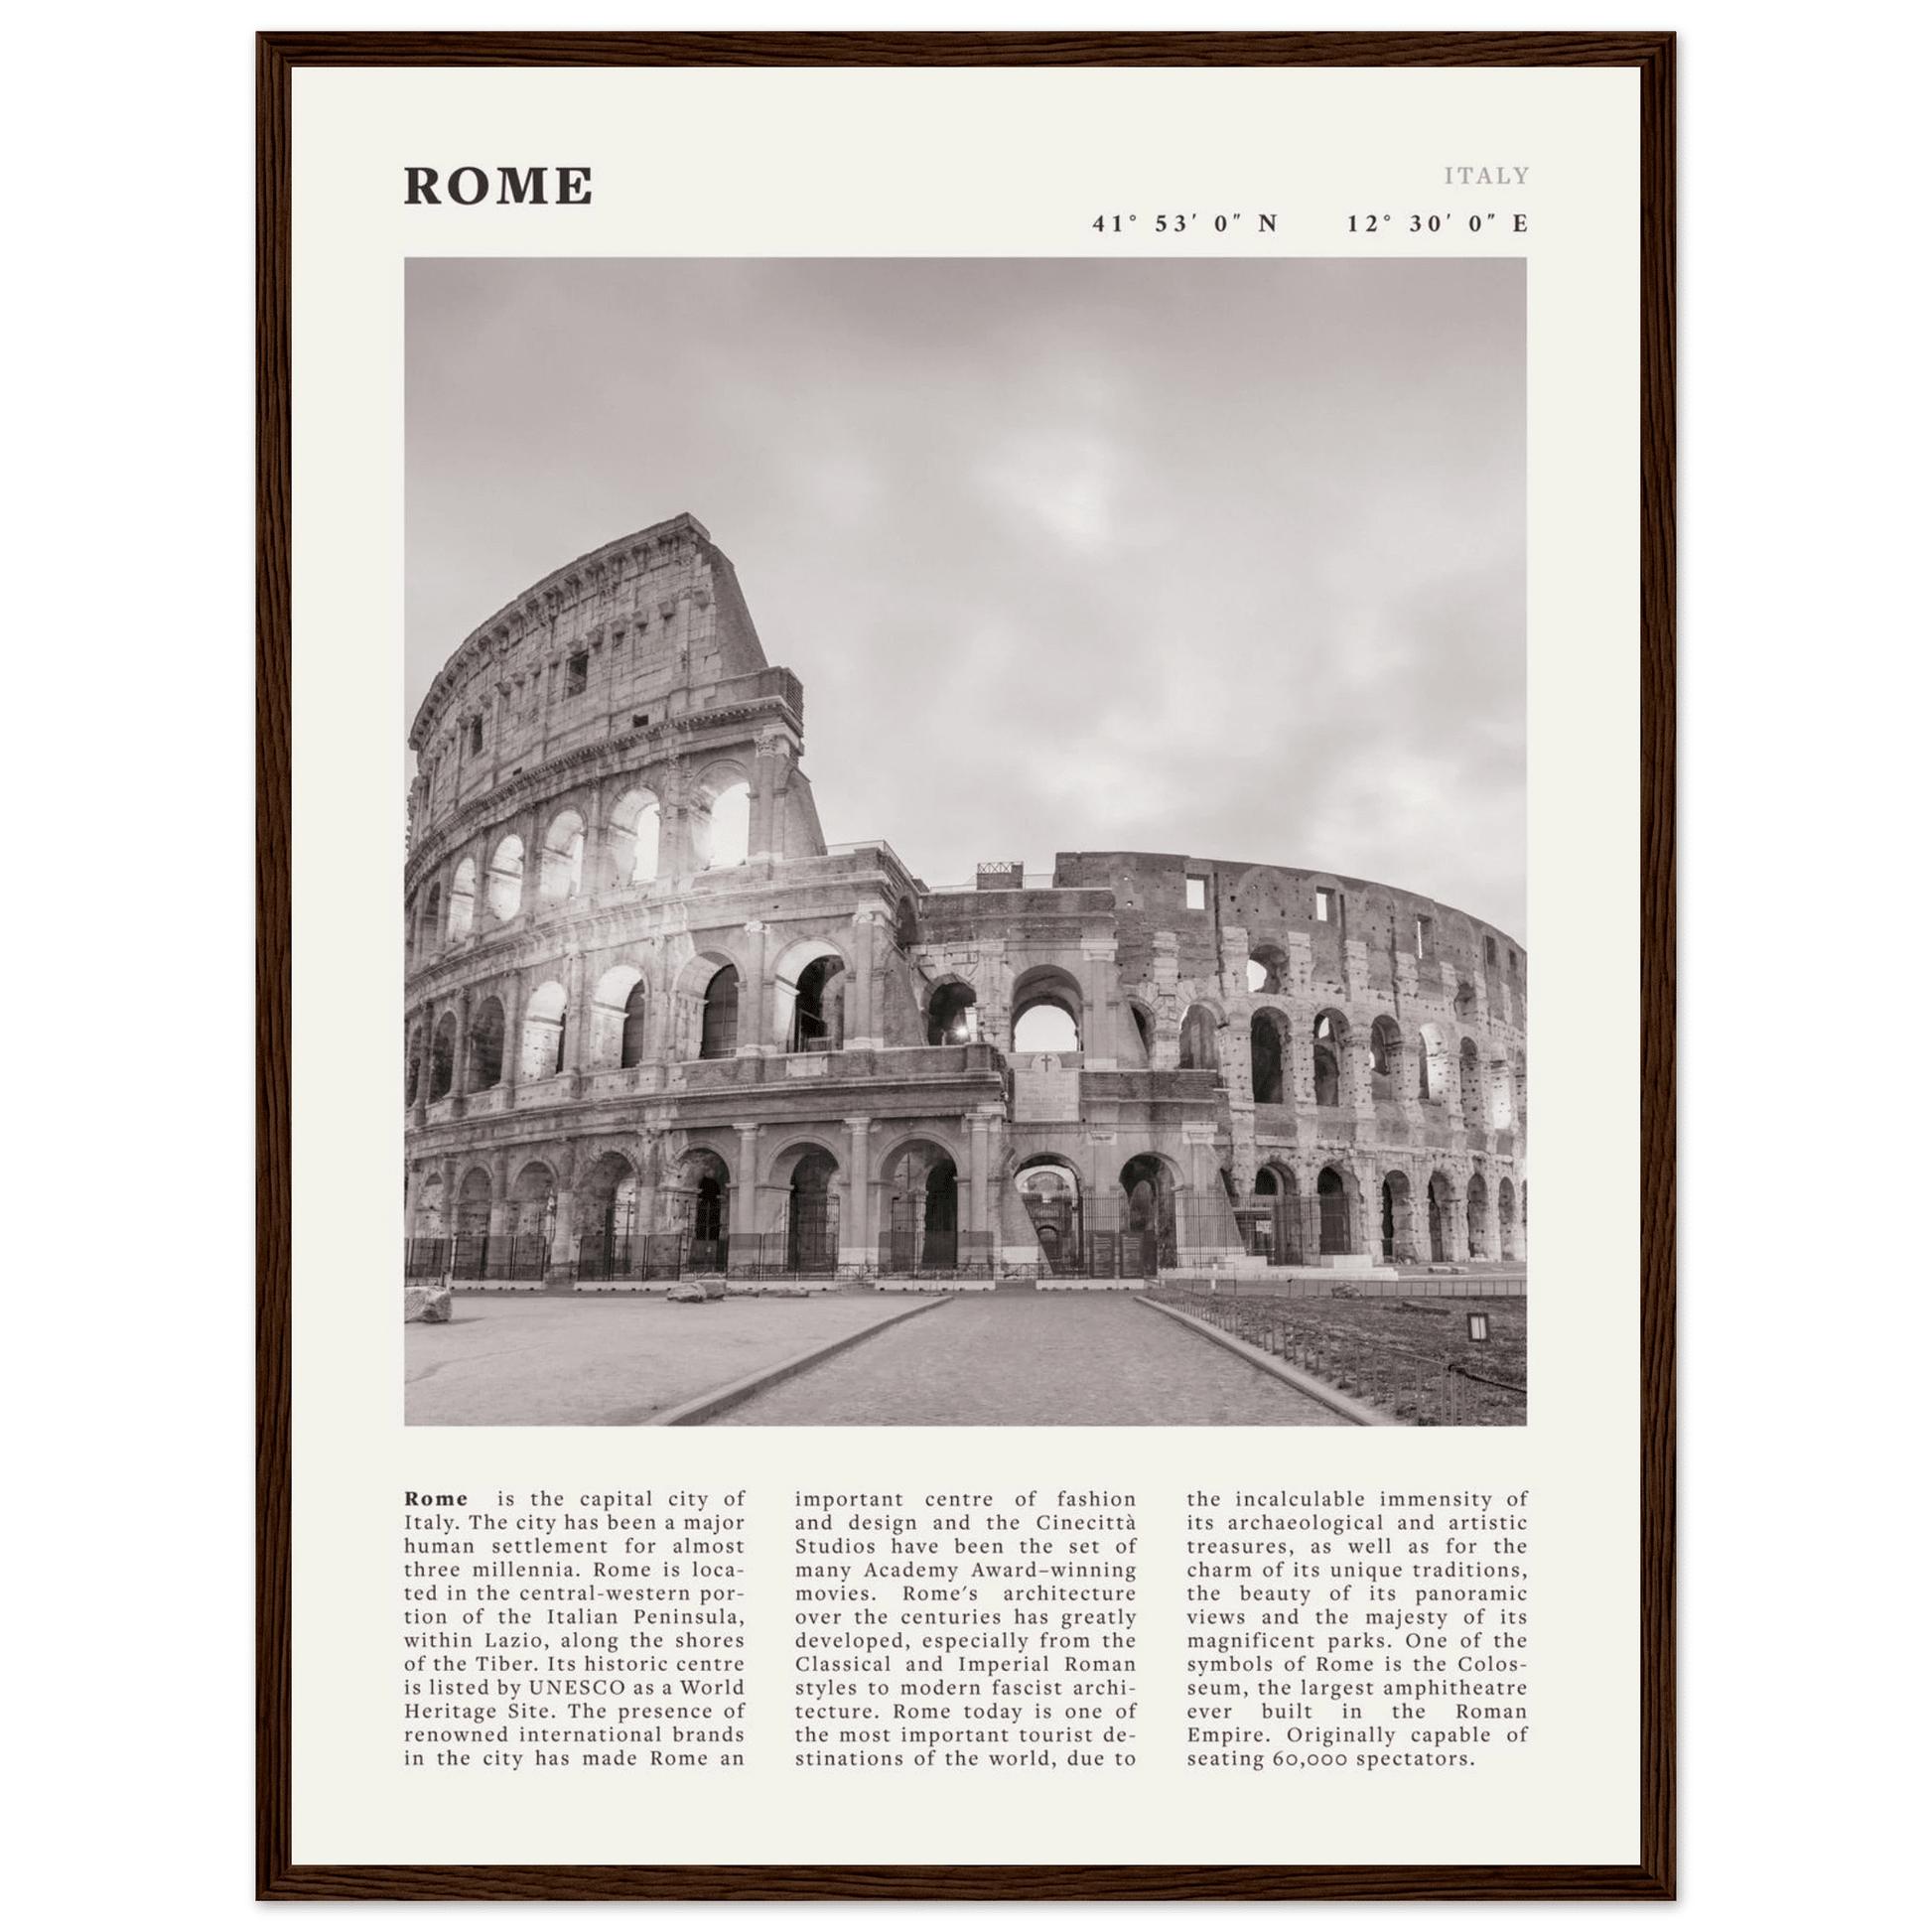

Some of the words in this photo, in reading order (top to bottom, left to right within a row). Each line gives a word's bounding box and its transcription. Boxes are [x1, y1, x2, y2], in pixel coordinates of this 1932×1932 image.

[403, 166, 593, 207] ROME
[1445, 166, 1530, 185] ITALY
[1258, 213, 1278, 233] N
[1512, 213, 1528, 233] E
[404, 1490, 468, 1507] Rome
[497, 1490, 515, 1507] is
[530, 1489, 564, 1507] the
[580, 1489, 652, 1512] capital
[668, 1490, 709, 1512] city
[723, 1489, 747, 1507] of
[795, 1490, 903, 1512] important
[924, 1493, 993, 1507] centre
[1015, 1489, 1037, 1507] of
[1056, 1489, 1136, 1507] fashion
[1186, 1489, 1221, 1507] the
[1236, 1489, 1365, 1507] incalculable
[1380, 1490, 1493, 1513] immensity
[1506, 1489, 1530, 1507] of
[404, 1513, 460, 1536] Italy.
[468, 1513, 508, 1531] The
[515, 1513, 557, 1536] city
[564, 1513, 599, 1531] has
[607, 1513, 656, 1531] been
[664, 1517, 675, 1531] a
[683, 1514, 746, 1536] major
[795, 1513, 833, 1531] and
[848, 1513, 917, 1536] design
[932, 1513, 971, 1531] and
[986, 1513, 1021, 1531] the
[1035, 1513, 1137, 1531] Cinecittà
[1187, 1514, 1214, 1531] its
[1228, 1513, 1383, 1536] archaeological
[1397, 1513, 1435, 1531] and
[1449, 1514, 1528, 1531] artistic
[404, 1537, 475, 1555] human
[491, 1537, 608, 1555] settlement
[624, 1537, 656, 1555] for
[672, 1537, 745, 1555] almost
[795, 1537, 876, 1555] Studios
[891, 1537, 939, 1555] have
[954, 1537, 1004, 1555] been
[1019, 1537, 1053, 1555] the
[1068, 1540, 1100, 1555] set
[1115, 1537, 1139, 1555] of
[1186, 1540, 1295, 1558] treasures,
[1311, 1541, 1331, 1555] as
[1347, 1537, 1392, 1555] well
[1408, 1541, 1430, 1555] as
[1446, 1537, 1477, 1555] for
[1493, 1537, 1528, 1555] the
[403, 1584, 438, 1601] ted
[447, 1585, 467, 1601] in
[477, 1584, 510, 1601] the
[519, 1584, 690, 1601] central-western
[700, 1588, 745, 1606] por-
[795, 1585, 877, 1601] movies.
[1003, 1584, 1136, 1601] architecture
[1186, 1584, 1221, 1601] the
[1239, 1584, 1311, 1607] beauty
[1329, 1584, 1352, 1601] of
[1369, 1585, 1396, 1601] its
[1415, 1585, 1528, 1606] panoramic
[404, 1607, 448, 1625] tion
[462, 1607, 485, 1625] of
[497, 1607, 532, 1625] the
[547, 1607, 619, 1625] Italian
[633, 1607, 745, 1628] Peninsula,
[794, 1612, 842, 1625] over
[854, 1607, 889, 1625] the
[900, 1608, 1002, 1625] centuries
[1014, 1607, 1048, 1625] has
[1060, 1607, 1137, 1630] greatly
[1186, 1608, 1246, 1625] views
[1262, 1607, 1300, 1625] and
[1314, 1607, 1349, 1625] the
[1365, 1608, 1448, 1630] majesty
[1463, 1607, 1486, 1625] of
[1500, 1608, 1528, 1625] its
[404, 1654, 427, 1672] of
[433, 1654, 467, 1672] the
[475, 1654, 538, 1672] Tiber.
[548, 1655, 576, 1672] Its
[584, 1654, 668, 1672] historic
[676, 1658, 745, 1672] centre
[795, 1655, 891, 1673] Classical
[905, 1654, 943, 1672] and
[958, 1654, 1049, 1677] Imperial
[1064, 1656, 1136, 1672] Roman
[1187, 1655, 1273, 1678] symbols
[1284, 1654, 1307, 1672] of
[1315, 1656, 1374, 1672] Rome
[1385, 1655, 1402, 1672] is
[1413, 1655, 1447, 1672] the
[1457, 1655, 1527, 1673] Colos-
[404, 1679, 422, 1696] is
[429, 1678, 489, 1696] listed
[496, 1678, 522, 1701] by
[528, 1679, 625, 1696] UNESCO
[633, 1683, 654, 1696] as
[662, 1683, 673, 1696] a
[679, 1678, 745, 1696] World
[1187, 1683, 1249, 1699] seum,
[1257, 1678, 1292, 1696] the
[1301, 1678, 1374, 1701] largest
[1383, 1678, 1528, 1701] amphitheatre
[404, 1702, 496, 1725] Heritage
[507, 1702, 556, 1720] Site.
[567, 1702, 607, 1720] The
[618, 1707, 713, 1725] presence
[723, 1702, 747, 1720] of
[794, 1706, 880, 1720] tecture.
[893, 1703, 951, 1720] Rome
[963, 1702, 1023, 1725] today
[1035, 1703, 1052, 1720] is
[1064, 1707, 1103, 1720] one
[1115, 1702, 1139, 1720] of
[1186, 1707, 1233, 1720] ever
[1261, 1702, 1312, 1720] built
[1342, 1702, 1362, 1720] in
[1392, 1702, 1426, 1720] the
[1455, 1703, 1527, 1720] Roman
[794, 1725, 829, 1743] the
[839, 1728, 891, 1743] most
[901, 1725, 1009, 1748] important
[1019, 1725, 1093, 1743] tourist
[1102, 1725, 1136, 1743] de-
[404, 1749, 424, 1766] in
[437, 1748, 471, 1766] the
[483, 1749, 523, 1771] city
[534, 1748, 570, 1766] has
[582, 1748, 637, 1766] made
[650, 1750, 708, 1766] Rome
[720, 1753, 745, 1766] an
[795, 1749, 903, 1767] stinations
[913, 1748, 937, 1766] of
[944, 1749, 979, 1767] the
[988, 1748, 1057, 1770] world,
[1066, 1748, 1105, 1766] due
[1114, 1752, 1137, 1766] to
[1186, 1749, 1265, 1772] seating
[1272, 1750, 1348, 1769] 60,000
[1356, 1752, 1475, 1772] spectators.
